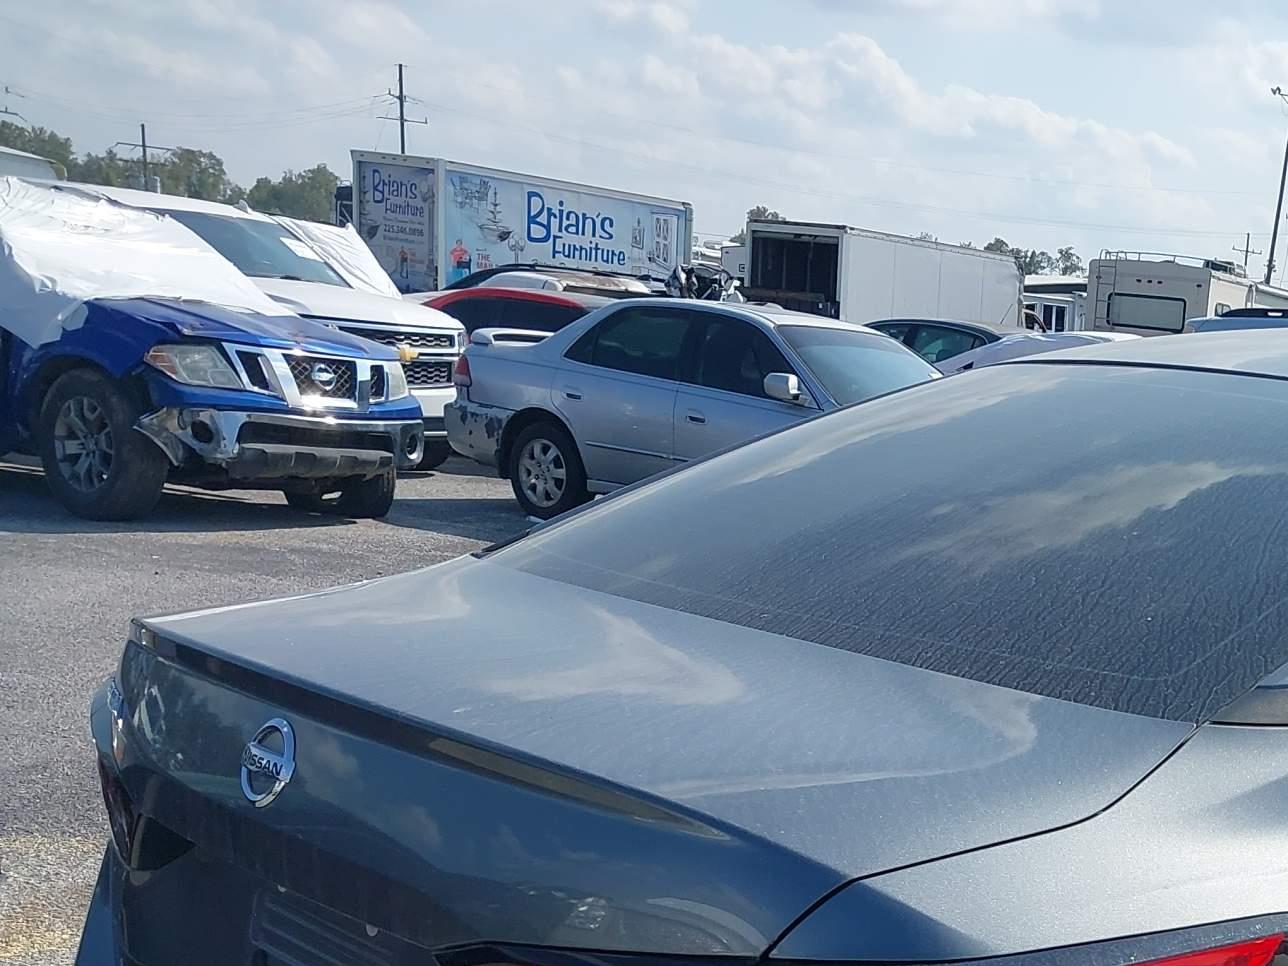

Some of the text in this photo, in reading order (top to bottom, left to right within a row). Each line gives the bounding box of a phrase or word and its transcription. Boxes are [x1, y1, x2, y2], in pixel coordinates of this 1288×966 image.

[373, 169, 417, 203] Brian's
[385, 198, 425, 217] Furniture
[527, 191, 614, 243] Brian's
[552, 234, 626, 266] Furniture
[244, 748, 283, 777] NISSAN
